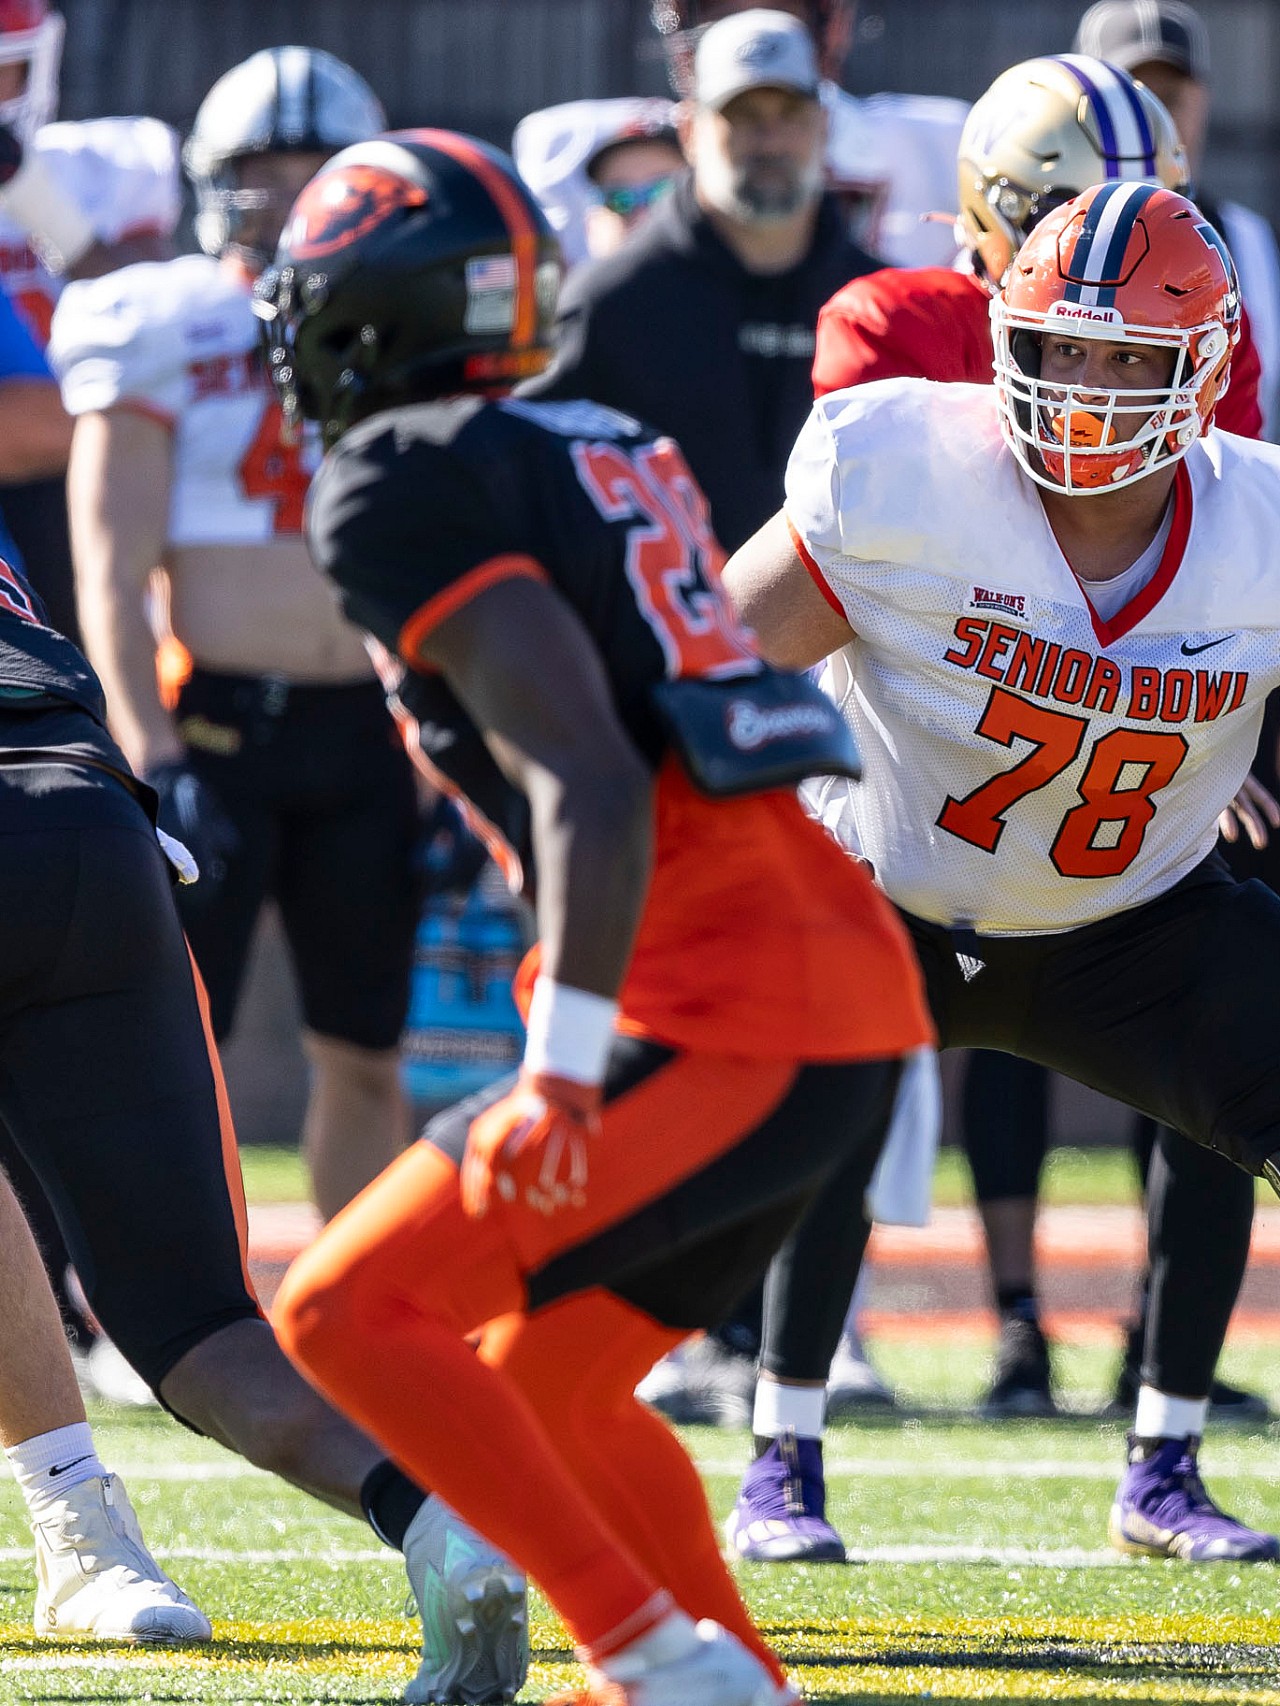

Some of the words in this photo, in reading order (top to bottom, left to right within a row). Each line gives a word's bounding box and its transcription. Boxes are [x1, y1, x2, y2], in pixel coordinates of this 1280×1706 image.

[1056, 305, 1114, 323] Riddell
[943, 616, 1122, 714] SENIOR
[935, 684, 1190, 880] 78
